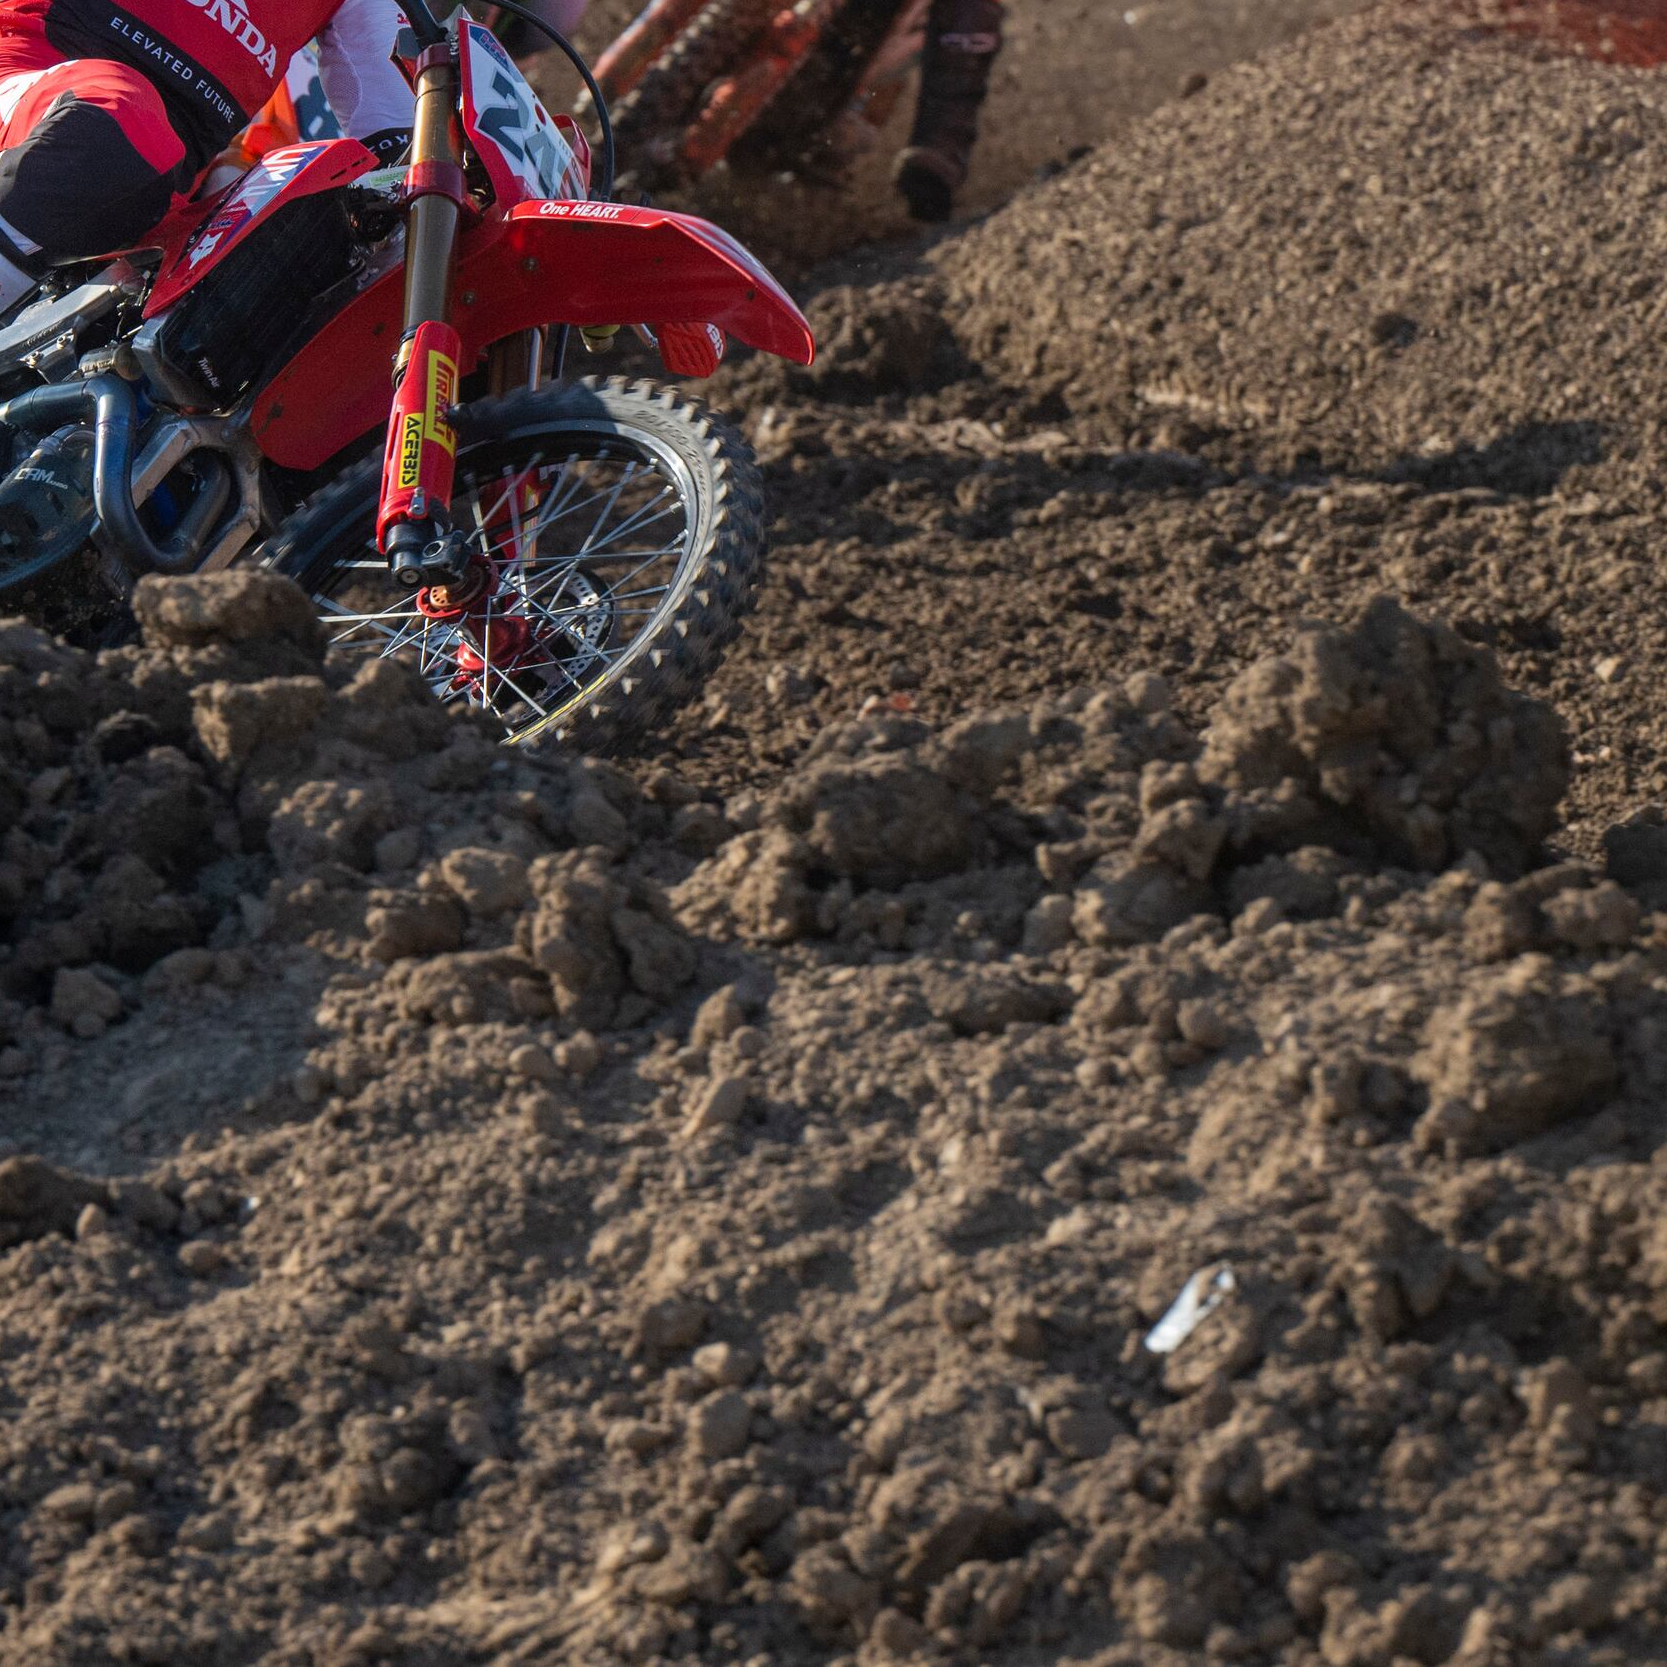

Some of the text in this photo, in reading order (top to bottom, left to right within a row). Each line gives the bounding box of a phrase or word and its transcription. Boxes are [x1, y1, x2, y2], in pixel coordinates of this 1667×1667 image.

[109, 16, 236, 125] ELEVATED FUTURE
[539, 201, 571, 218] One
[399, 414, 422, 489] ACERBIS
